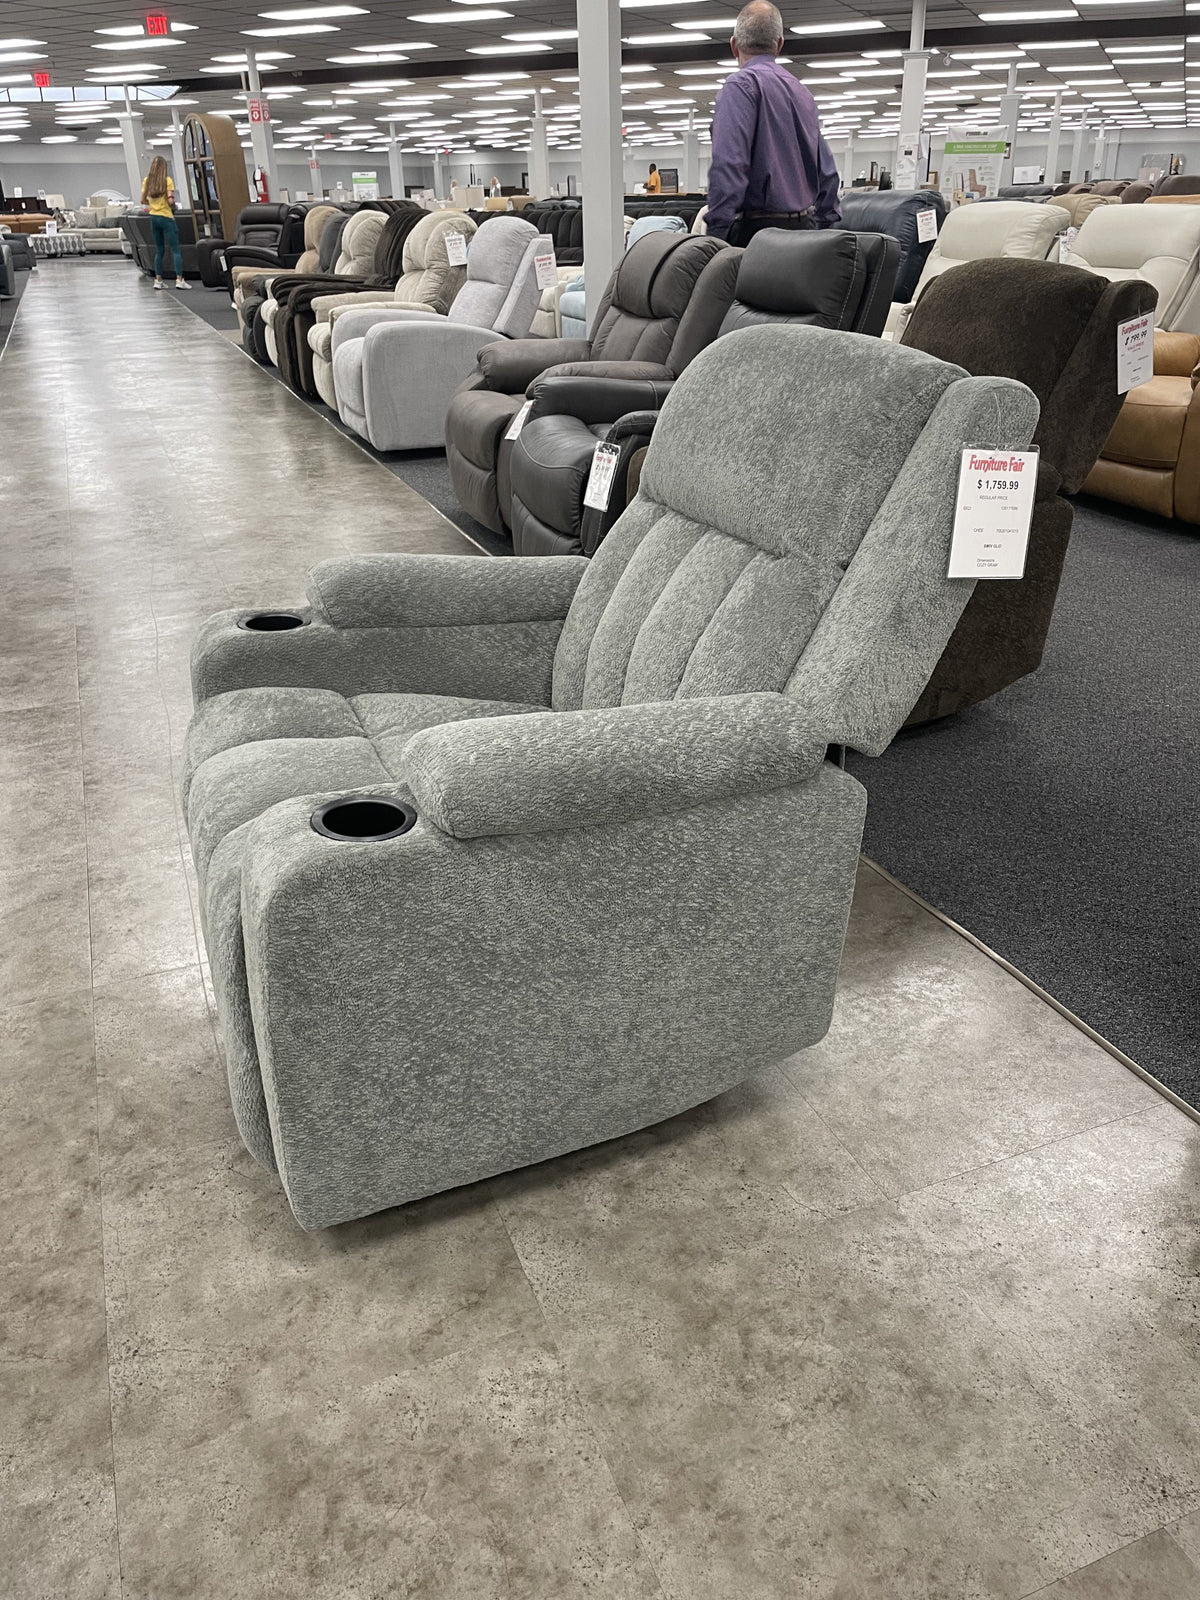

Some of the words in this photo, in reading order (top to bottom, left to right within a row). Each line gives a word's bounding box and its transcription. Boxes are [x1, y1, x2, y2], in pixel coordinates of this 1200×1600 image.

[146, 17, 168, 35] EXIT
[1130, 330, 1147, 342] 799.99
[969, 454, 1007, 472] Furniture
[1008, 457, 1025, 472] Fair
[977, 479, 983, 490] $
[985, 480, 1019, 490] 1,759.99
